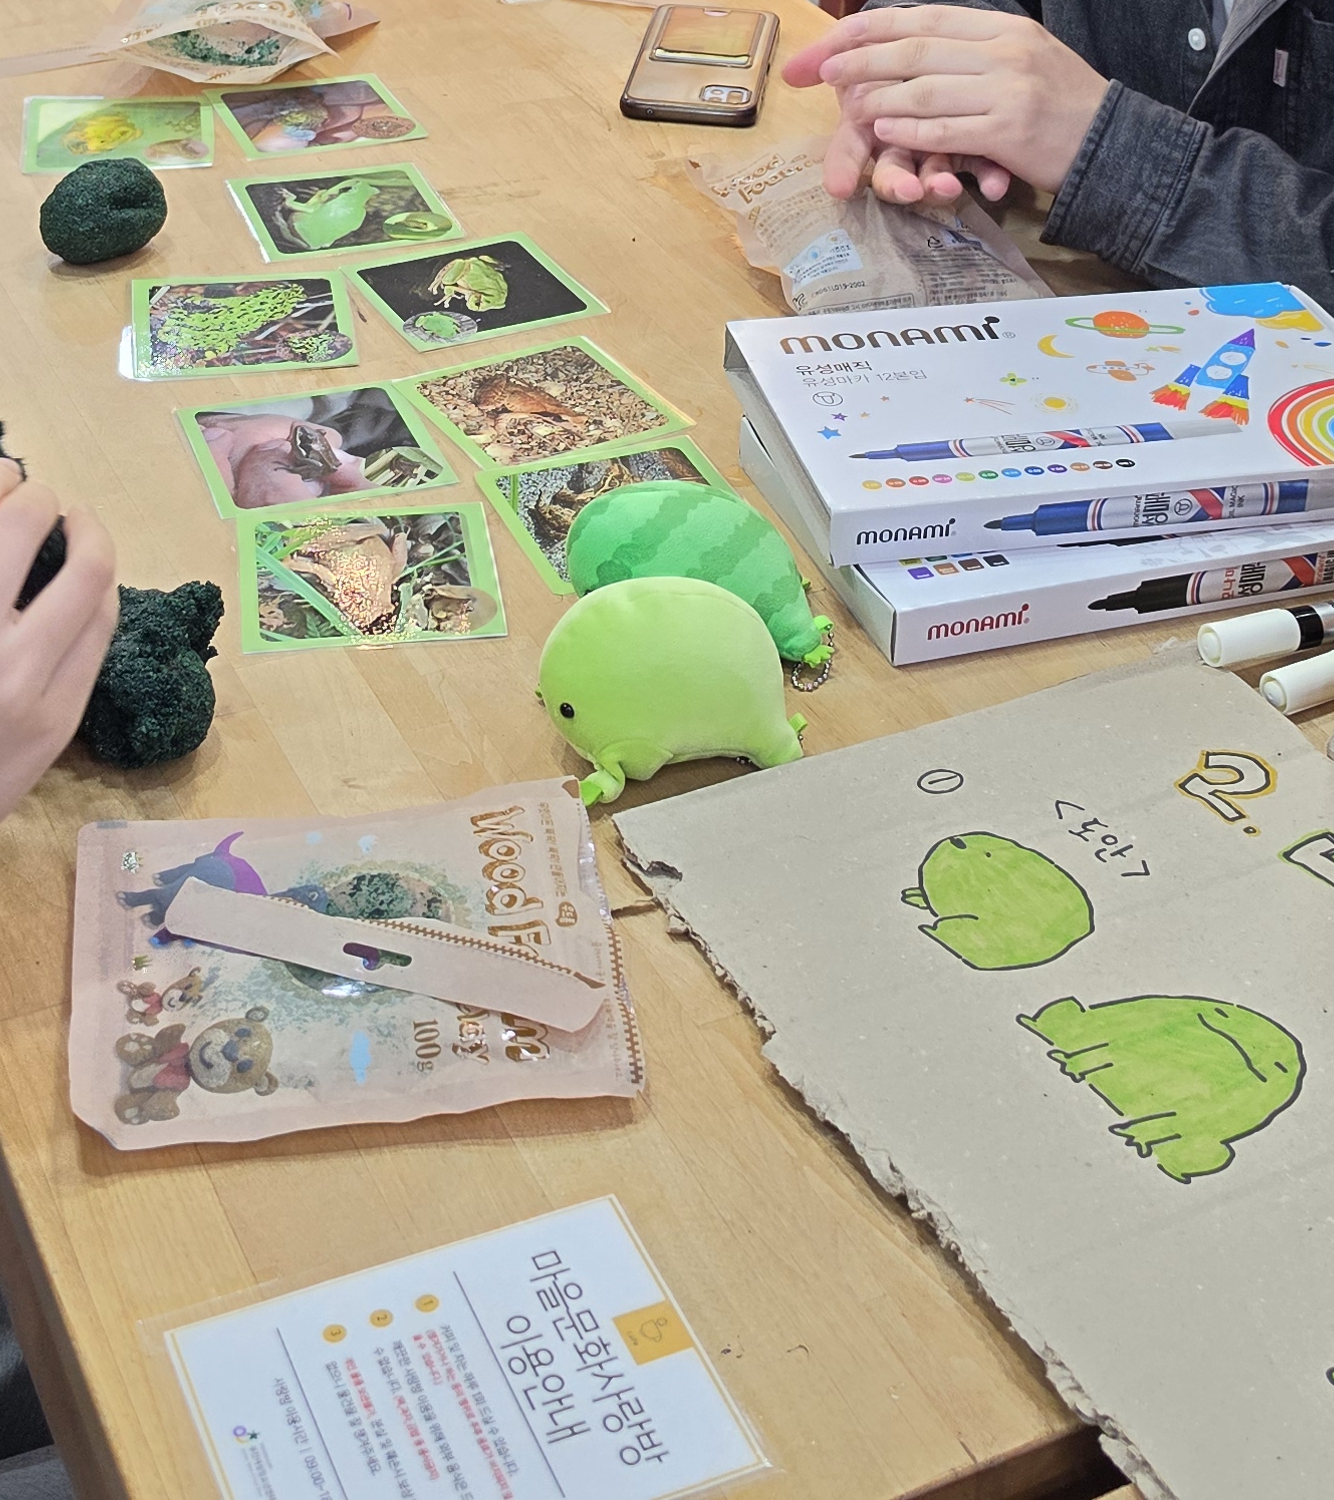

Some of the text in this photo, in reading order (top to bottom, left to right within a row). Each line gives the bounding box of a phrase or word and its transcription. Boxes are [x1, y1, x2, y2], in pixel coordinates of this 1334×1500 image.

[795, 360, 873, 376] 유성매직
[802, 368, 929, 388] 유성마카 12본입
[856, 517, 956, 546] monami
[926, 602, 1030, 641] monami
[469, 804, 543, 917] Wood
[503, 1313, 592, 1446] 이용안내
[528, 1247, 670, 1468] 마을문화사랑방
[267, 1376, 313, 1446] 사랑방 이용시간
